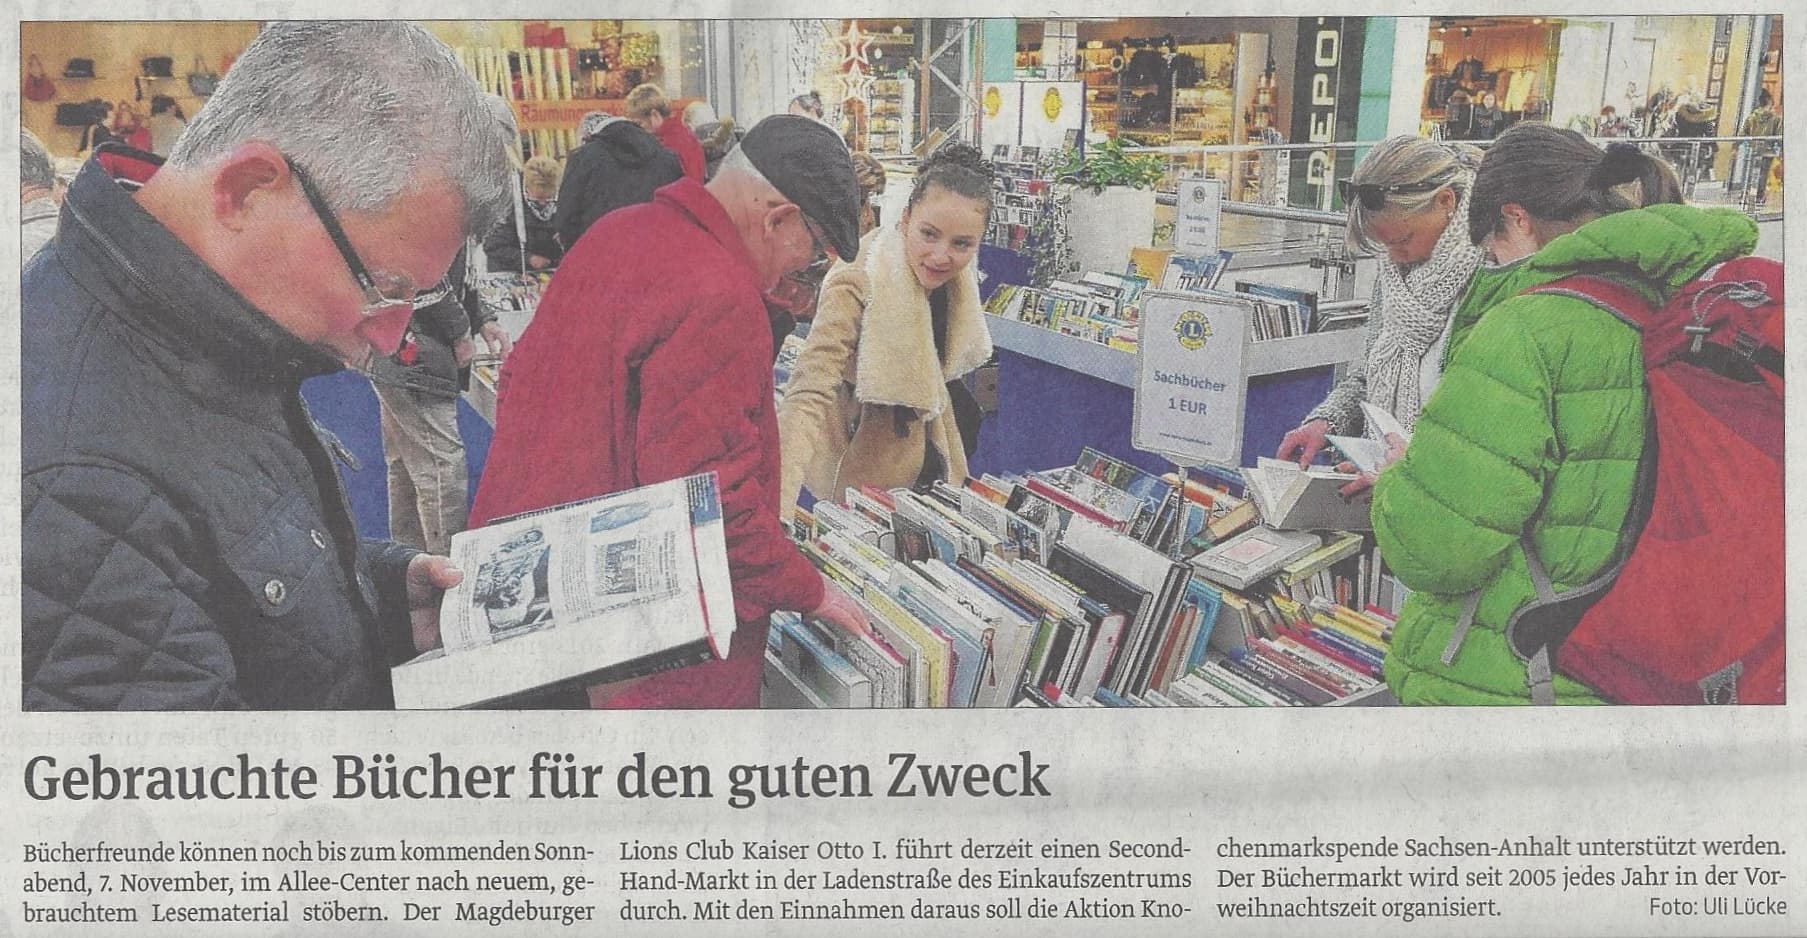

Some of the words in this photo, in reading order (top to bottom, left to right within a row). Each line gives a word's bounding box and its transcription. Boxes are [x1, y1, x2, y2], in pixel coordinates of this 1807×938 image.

[1307, 16, 1340, 185] DEPO
[1153, 370, 1226, 392] Sachbücher
[1168, 398, 1177, 410] 1
[1180, 400, 1207, 415] EUR
[24, 753, 317, 801] Gebrauchte
[332, 752, 516, 800] Bücher
[528, 751, 603, 799] für
[617, 751, 714, 799] den
[727, 756, 873, 809] guten
[887, 750, 1052, 797] Zweck
[23, 840, 175, 863] Bücherfreunde
[179, 840, 258, 862] können
[262, 840, 313, 862] noch
[317, 840, 346, 862] bis
[350, 846, 397, 862] zum
[400, 839, 531, 861] kommenden
[534, 842, 594, 861] Sonn-
[620, 839, 678, 861] Lions
[686, 838, 734, 860] Club
[743, 839, 810, 860] Kaiser
[817, 841, 864, 860] Otto
[872, 841, 887, 860] I.
[895, 838, 953, 859] führt
[961, 838, 1033, 859] derzeit
[1041, 838, 1101, 859] einen
[1109, 836, 1191, 858] Second-
[1217, 836, 1399, 863] chenmarkspende
[1405, 835, 1571, 857] Sachsen-Anhalt
[1577, 838, 1697, 856] unterstützt
[1702, 834, 1786, 856] werden.
[23, 871, 92, 897] abend,
[99, 875, 113, 892] 7.
[120, 870, 234, 896] November,
[241, 871, 272, 892] im
[277, 869, 410, 892] Allee-Center
[416, 869, 470, 891] nach
[476, 876, 556, 895] neuem,
[562, 875, 594, 897] ge-
[620, 868, 749, 891] Hand-Markt
[755, 869, 778, 890] in
[784, 868, 817, 890] der
[823, 867, 952, 890] Ladenstraße
[958, 867, 992, 889] des
[998, 867, 1192, 889] Einkaufszentrums
[1217, 869, 1256, 888] Der
[1261, 865, 1402, 888] Büchermarkt
[1408, 865, 1459, 887] wird
[1466, 866, 1503, 887] seit
[1509, 869, 1556, 887] 2005
[1562, 864, 1615, 892] jedes
[1621, 864, 1670, 886] Jahr
[1675, 865, 1697, 886] in
[1705, 864, 1739, 886] der
[1744, 867, 1787, 886] Vor-
[23, 901, 138, 923] brauchtem
[151, 900, 289, 922] Lesematerial
[303, 899, 388, 922] stöbern.
[403, 903, 442, 921] Der
[454, 899, 596, 927] Magdeburger
[620, 898, 687, 921] durch.
[693, 899, 731, 921] Mit
[736, 898, 774, 920] den
[780, 898, 905, 920] Einnahmen
[910, 898, 980, 919] daraus
[986, 897, 1022, 919] soll
[1027, 897, 1058, 919] die
[1063, 897, 1135, 919] Aktion
[1140, 899, 1191, 918] Kno-
[1216, 896, 1377, 918] weihnachtszeit
[1382, 896, 1501, 923] organisiert.
[1650, 897, 1698, 916] Foto:
[1704, 896, 1727, 915] Uli
[1734, 896, 1787, 915] Lücke
